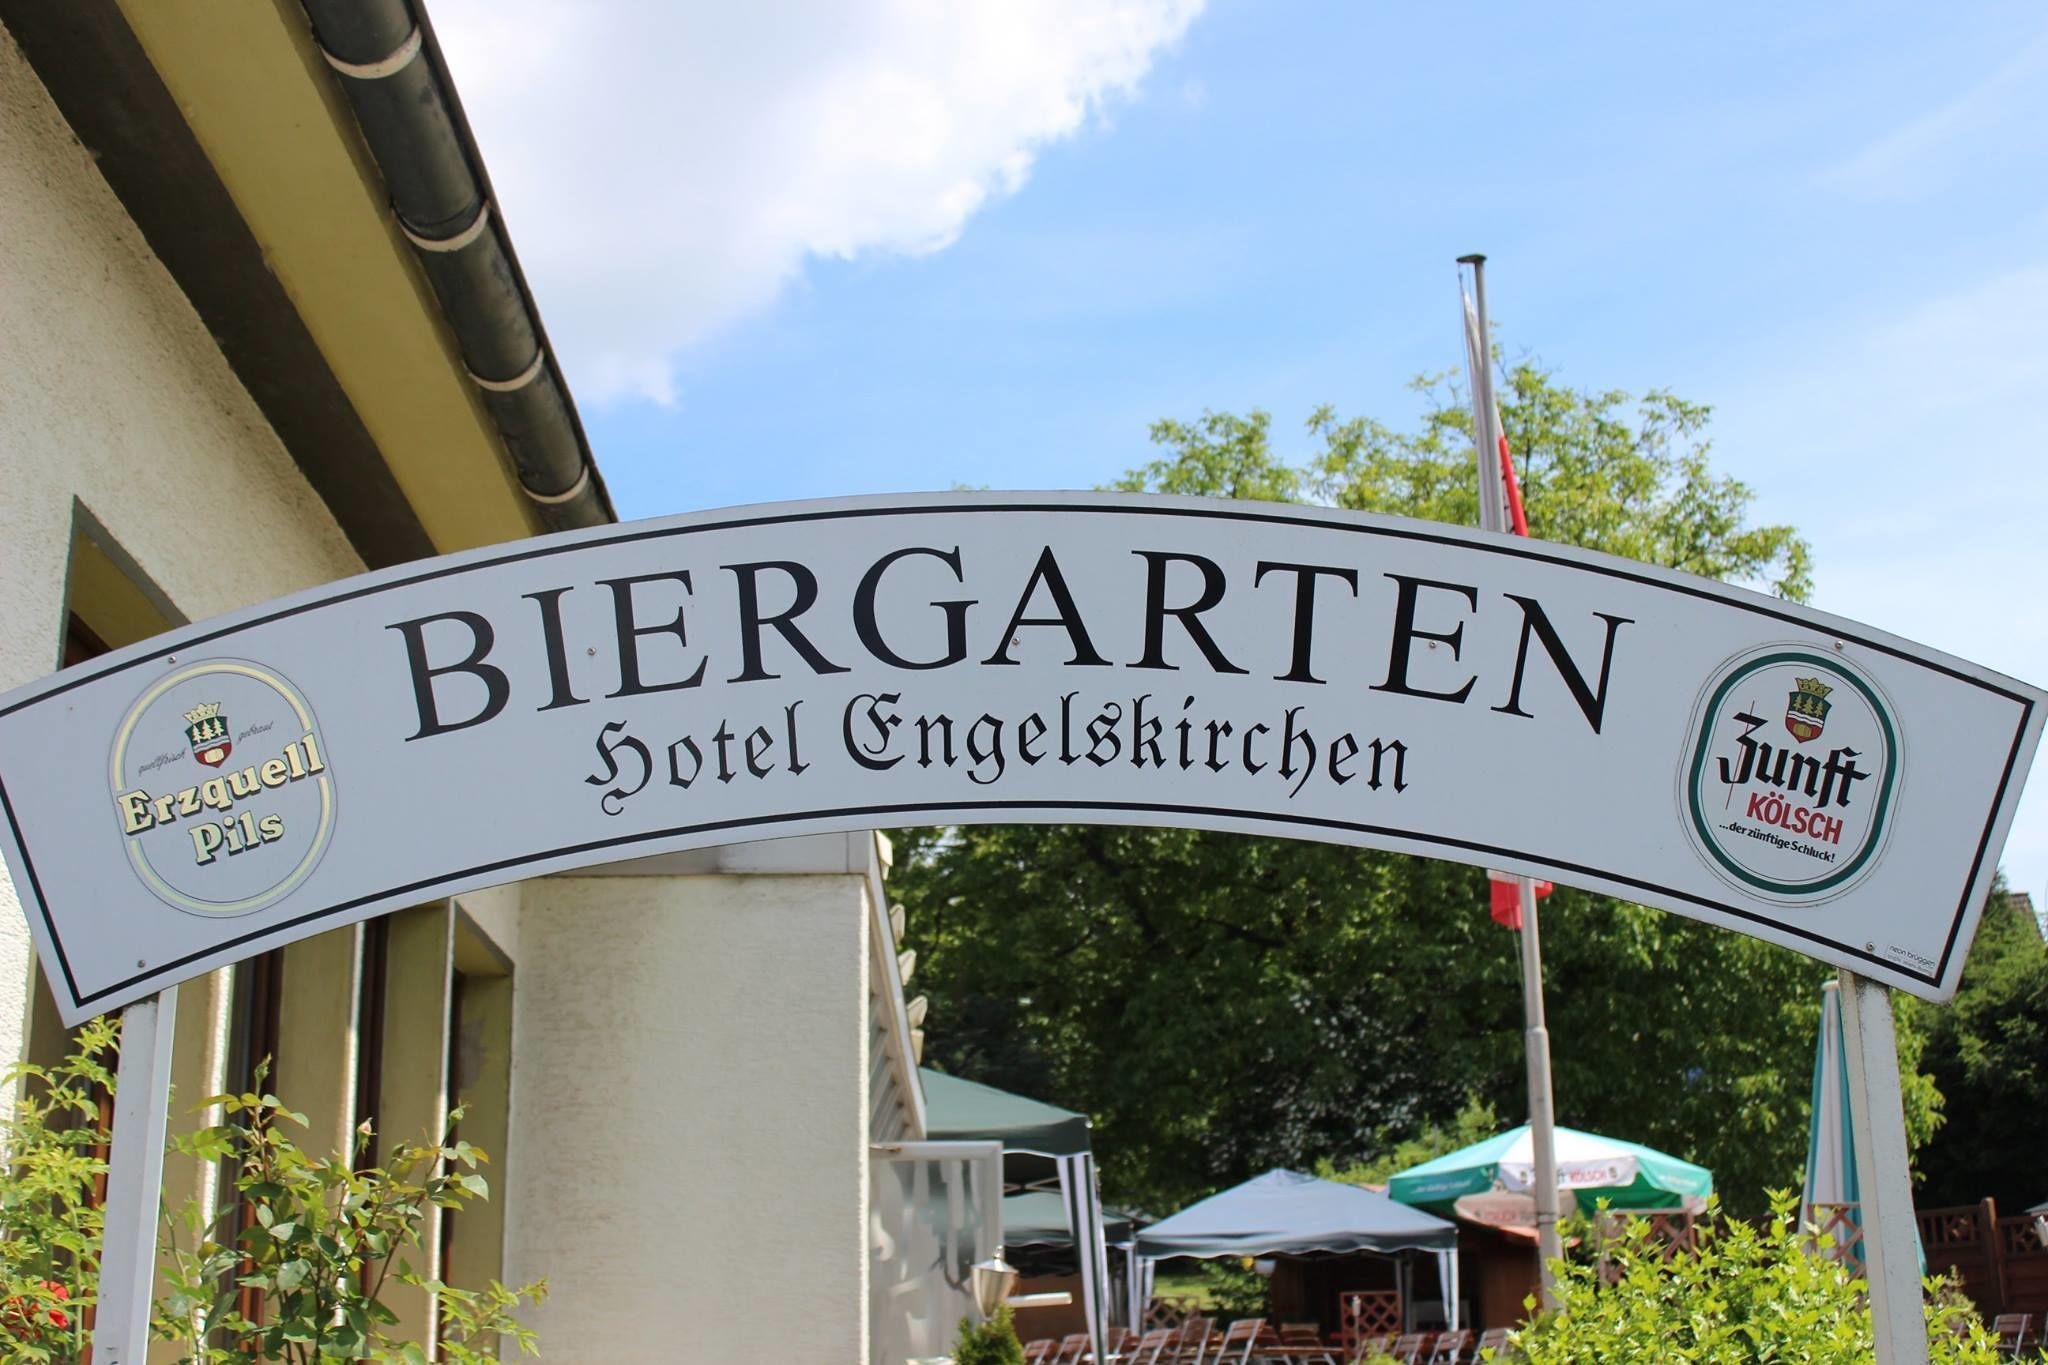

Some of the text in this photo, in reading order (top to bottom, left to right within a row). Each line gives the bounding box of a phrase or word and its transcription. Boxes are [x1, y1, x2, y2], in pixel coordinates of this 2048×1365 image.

[385, 545, 1635, 741] BIERGARTEN
[116, 732, 325, 836] Erzquell
[584, 691, 1409, 816] Hotel Engelskirchen
[1716, 700, 1871, 809] Zunft
[188, 809, 285, 867] Pils
[1746, 791, 1844, 845] KÖLSCH
[1747, 828, 1790, 850] zünftige
[1790, 840, 1836, 863] Schluck!
